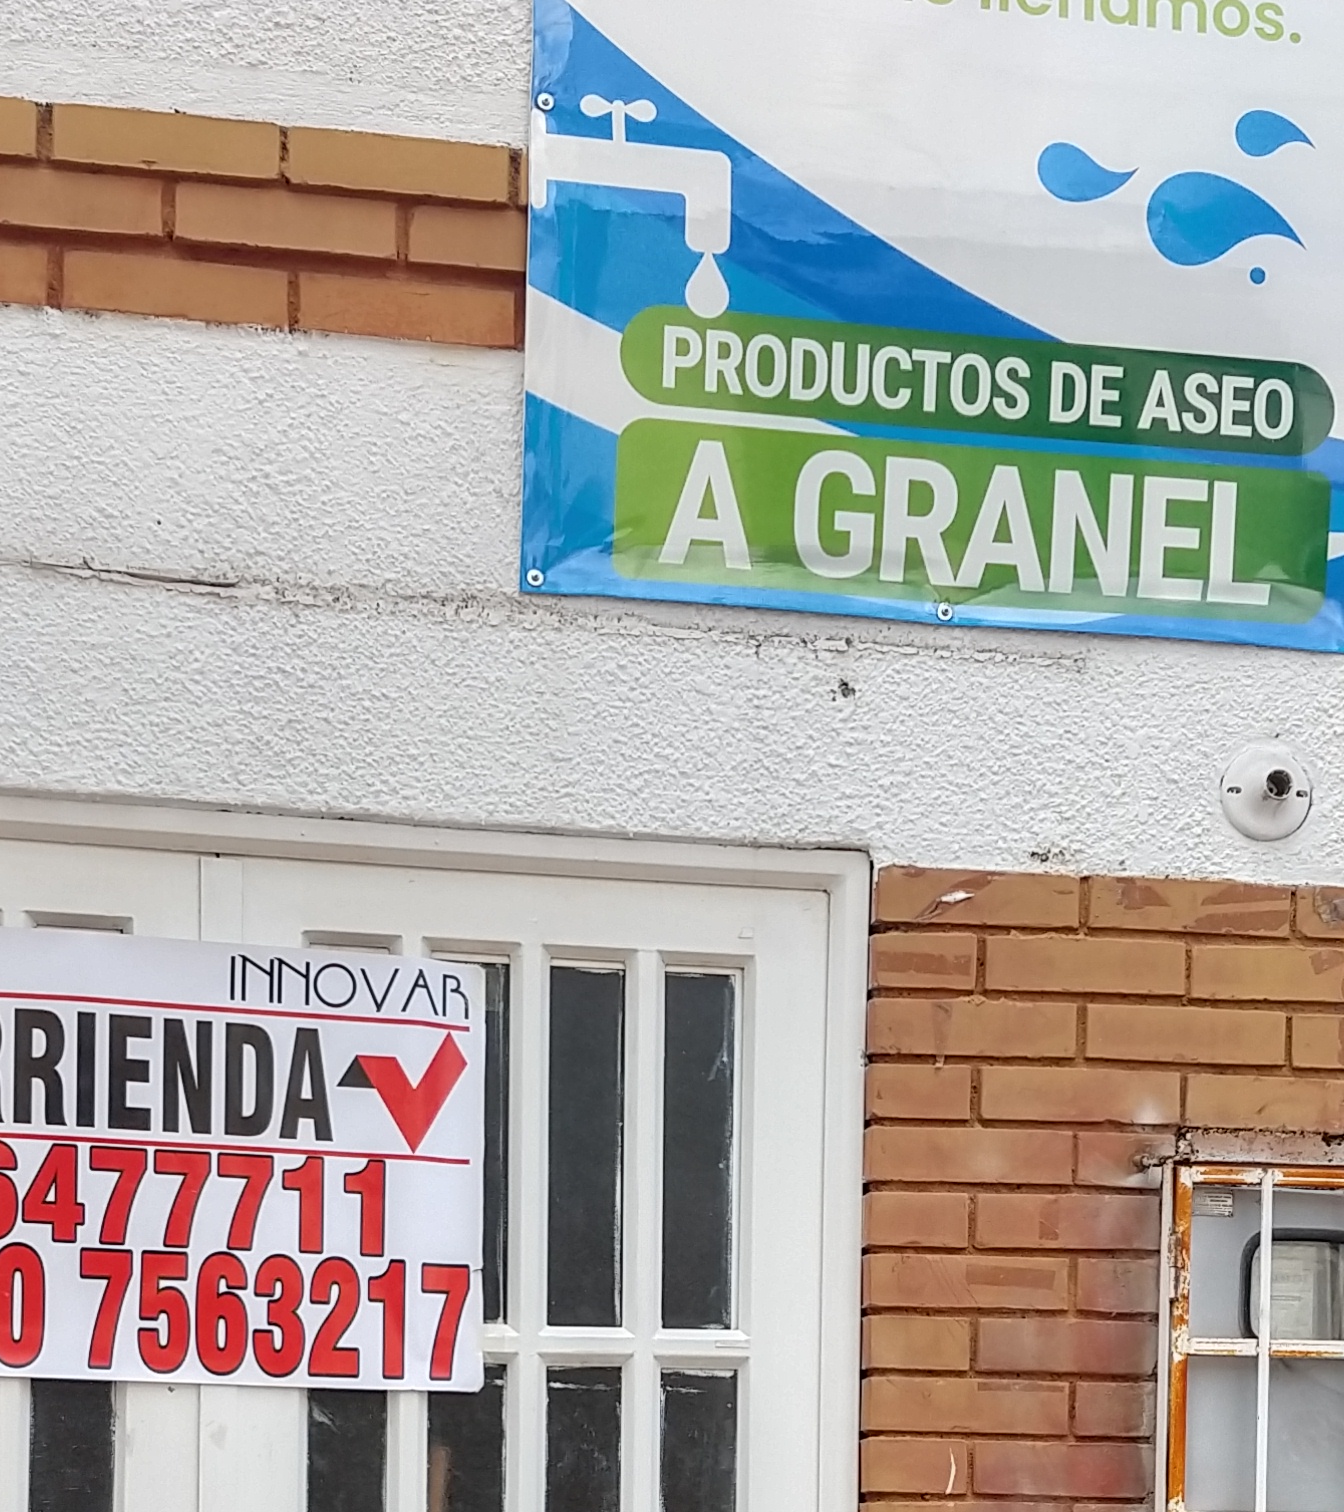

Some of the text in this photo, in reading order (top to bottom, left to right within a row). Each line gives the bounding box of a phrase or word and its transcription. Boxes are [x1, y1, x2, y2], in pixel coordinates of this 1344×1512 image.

[979, 0, 1302, 44] namos.
[661, 324, 1295, 441] PRODUCTOS DE ASEO
[657, 439, 1272, 607] A GRANEL
[228, 952, 471, 1021] INNOVAR
[79, 1247, 472, 1381] 7563217
